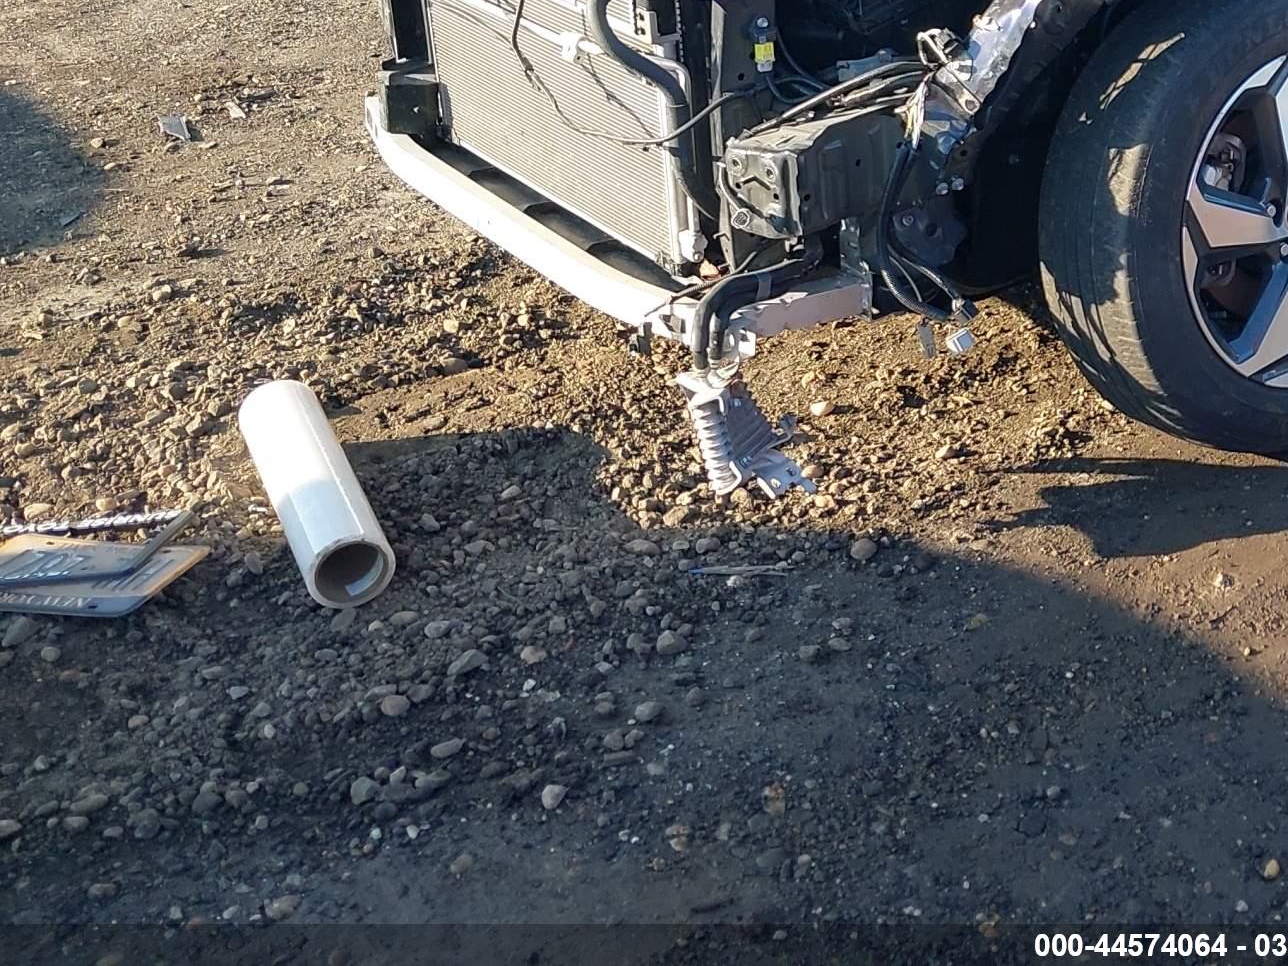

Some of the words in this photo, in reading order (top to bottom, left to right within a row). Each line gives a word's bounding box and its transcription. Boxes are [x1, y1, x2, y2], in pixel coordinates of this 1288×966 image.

[77, 509, 182, 528] SUNRISE
[0, 521, 71, 535] TOYO
[0, 592, 39, 606] YOR
